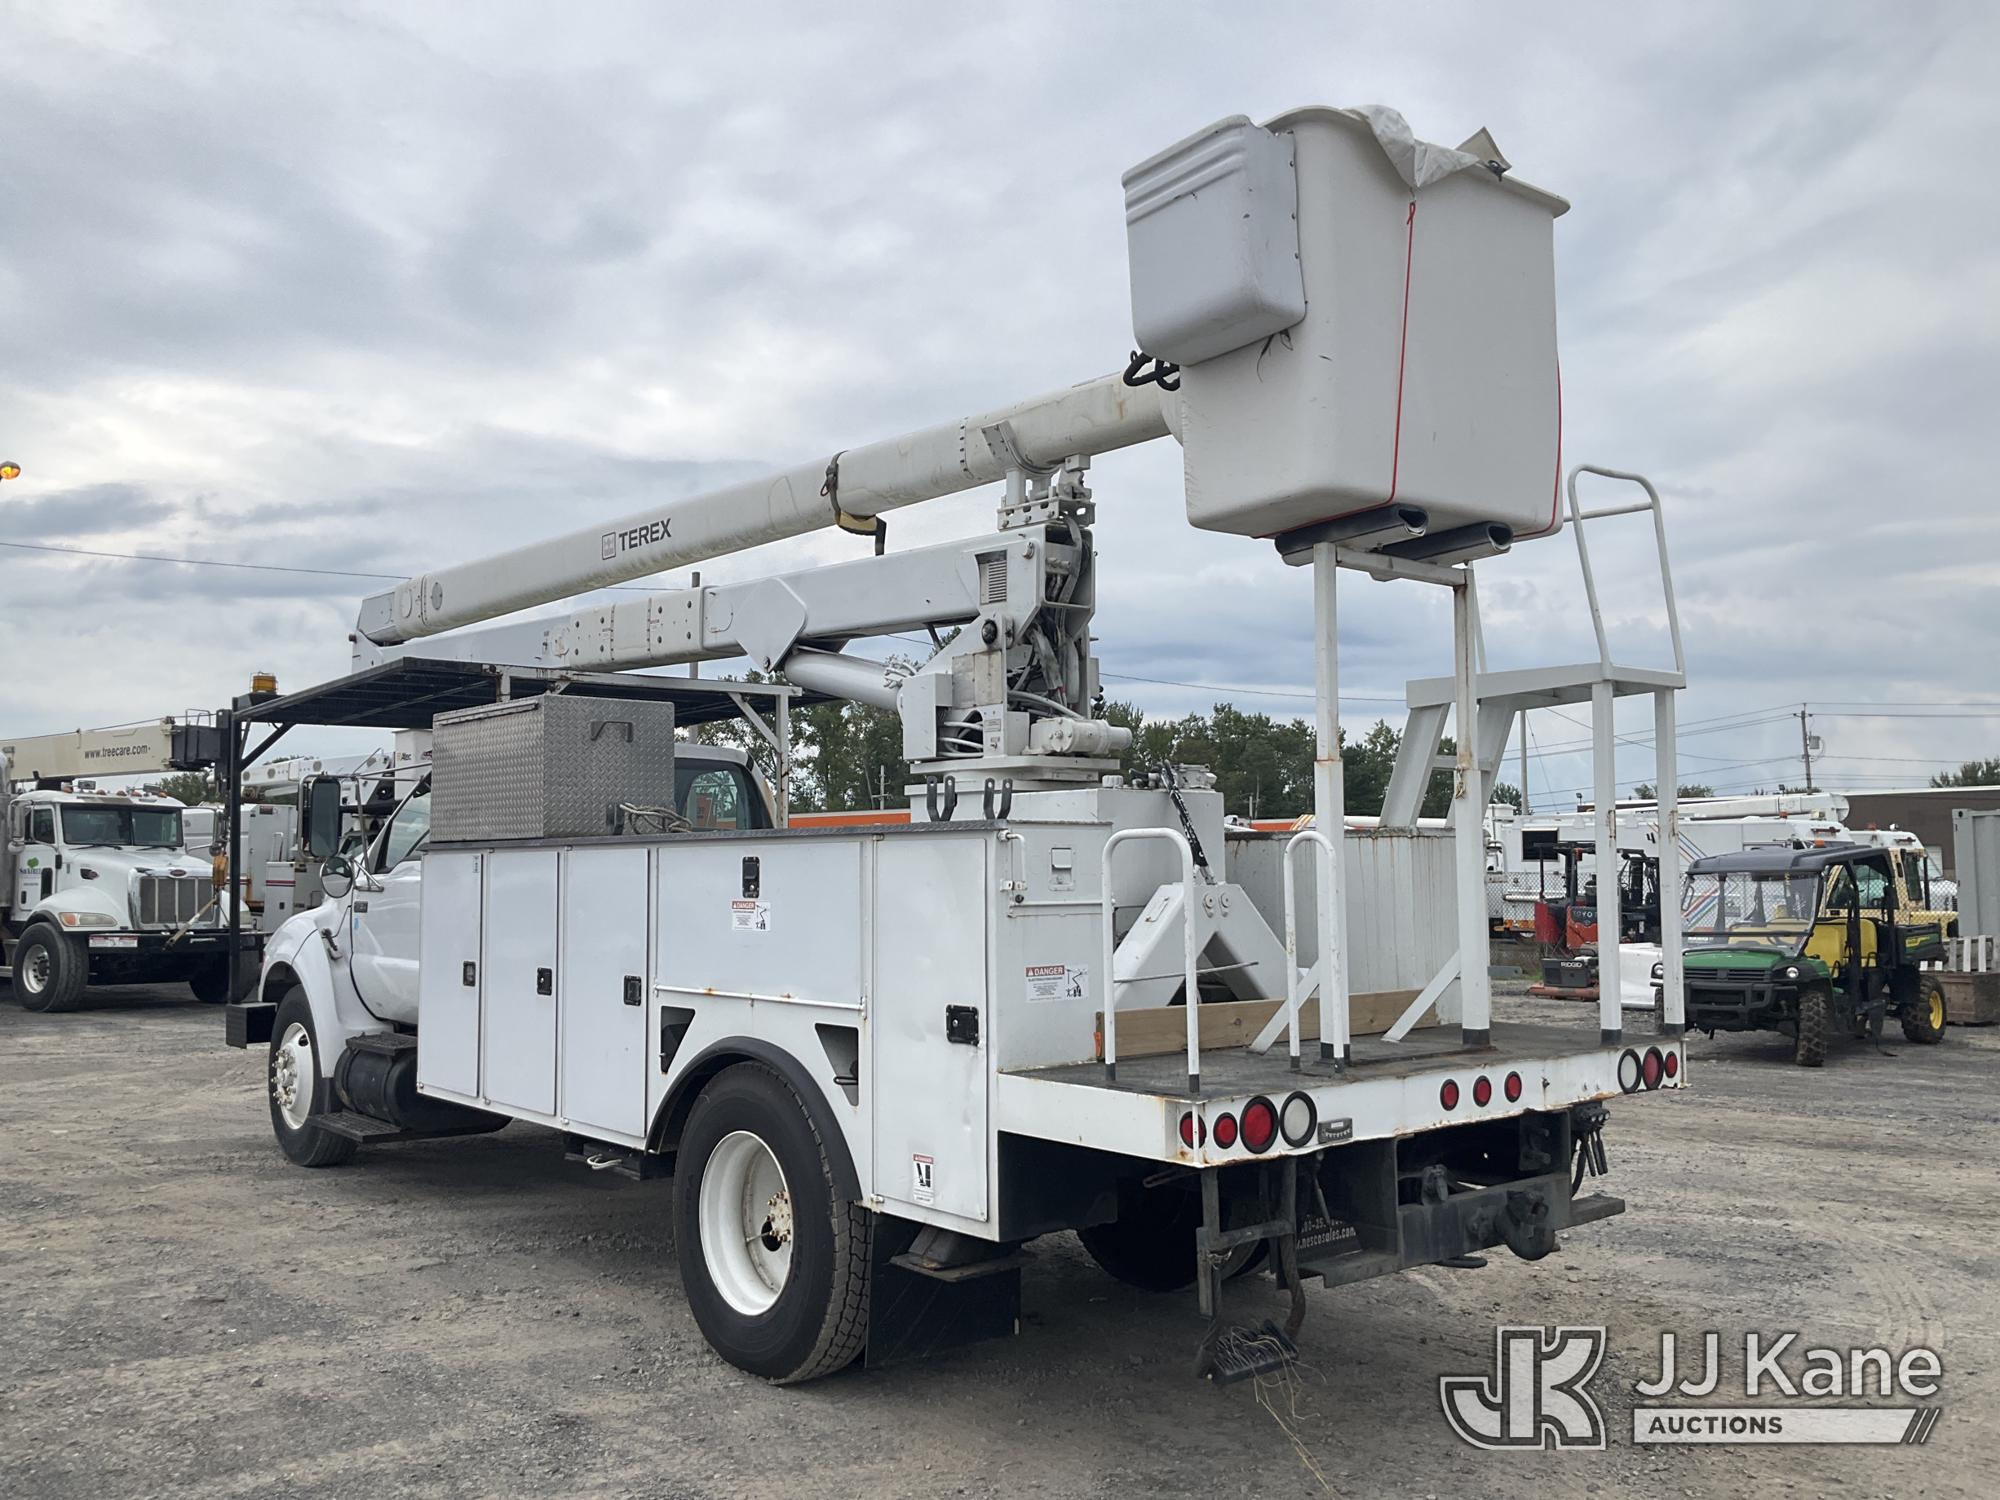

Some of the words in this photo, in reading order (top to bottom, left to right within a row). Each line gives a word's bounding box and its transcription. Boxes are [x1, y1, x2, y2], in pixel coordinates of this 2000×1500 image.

[618, 518, 672, 551] TEREX
[84, 744, 149, 759] www.treecare.com
[1573, 910, 1598, 918] TOYO
[1034, 966, 1063, 976] DANGER
